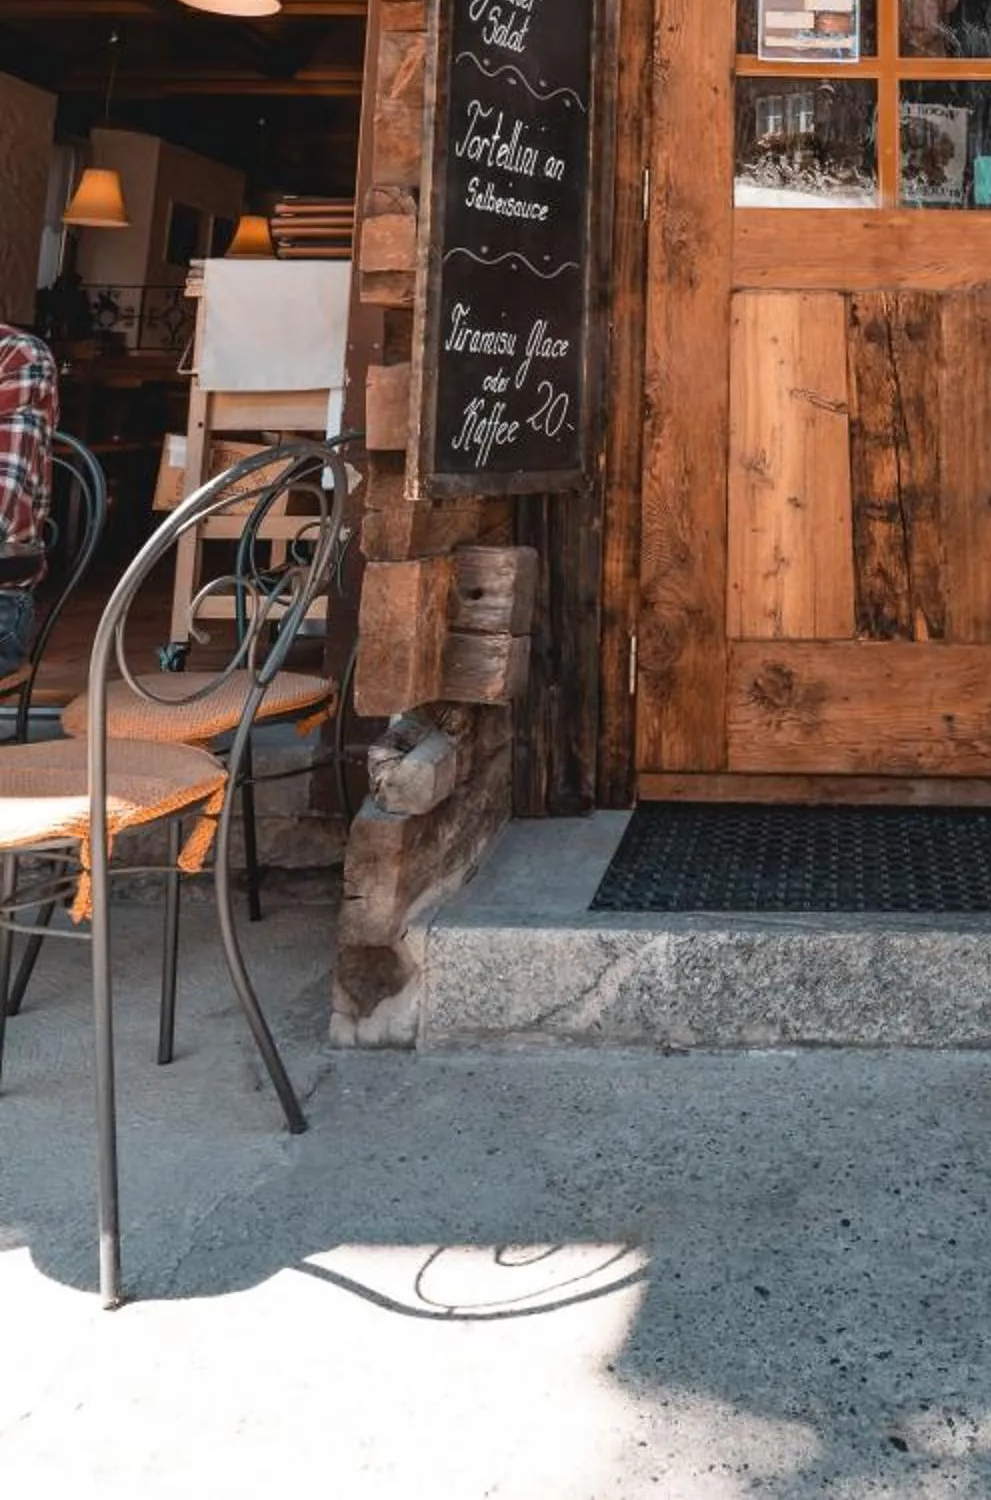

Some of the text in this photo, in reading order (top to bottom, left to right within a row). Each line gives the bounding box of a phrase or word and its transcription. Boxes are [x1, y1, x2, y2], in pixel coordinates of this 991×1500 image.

[482, 5, 531, 53] Salat
[455, 99, 566, 182] Tortellini an
[465, 176, 550, 222] Salbeisauce
[445, 302, 517, 357] Tiramisu
[482, 367, 512, 393] oder
[451, 397, 521, 468] Kaffee
